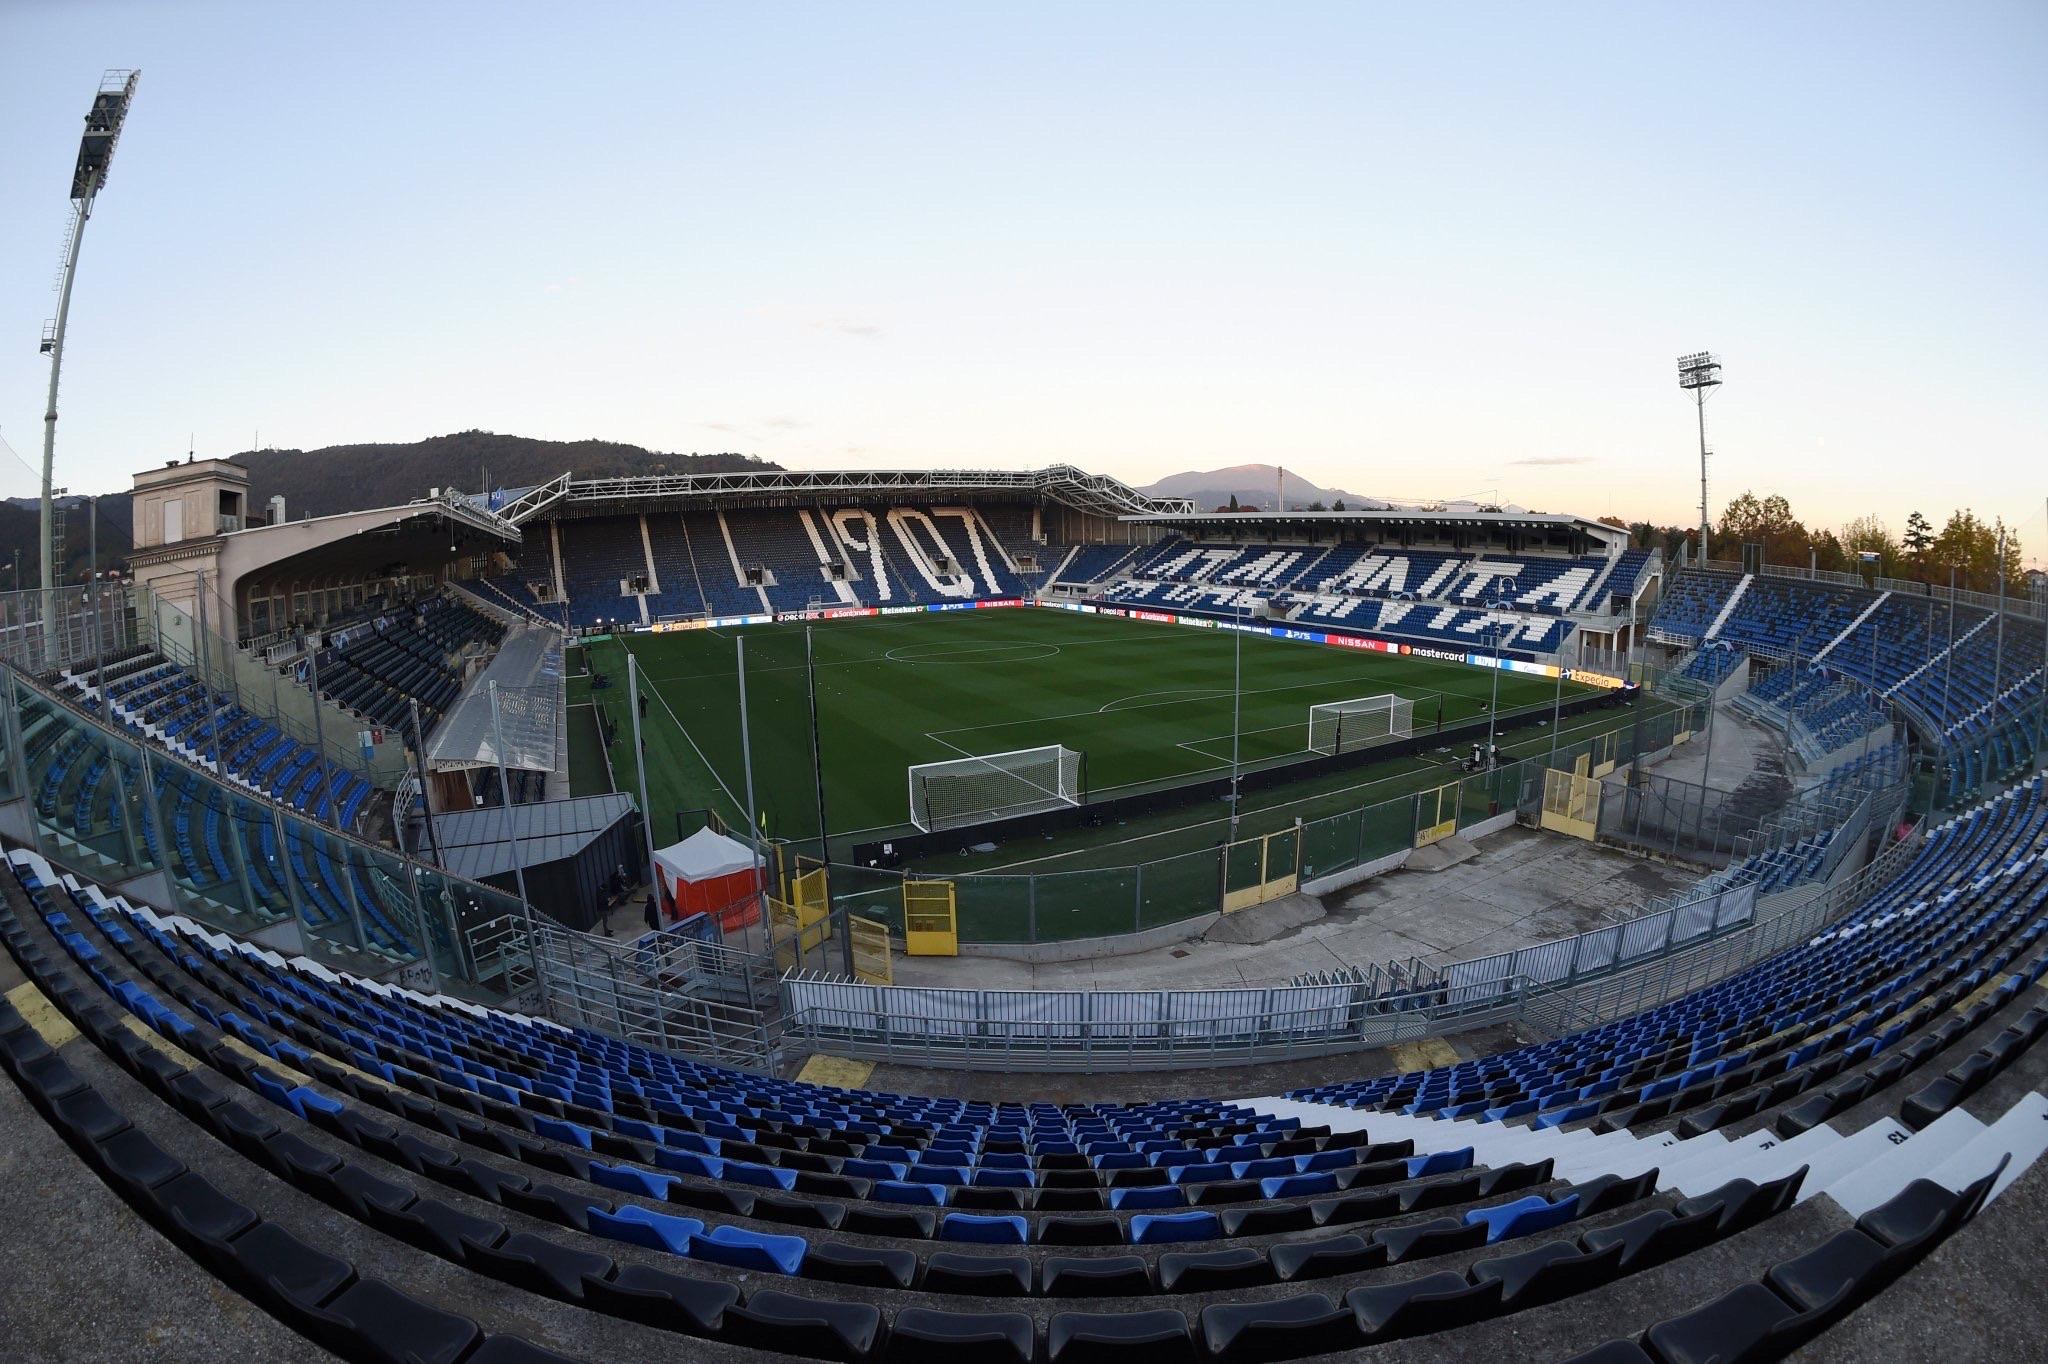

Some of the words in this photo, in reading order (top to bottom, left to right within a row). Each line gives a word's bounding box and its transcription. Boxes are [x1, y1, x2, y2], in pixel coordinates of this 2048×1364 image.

[799, 507, 1003, 603] 1907
[838, 609, 872, 618] Santander
[881, 606, 917, 614] Heineken
[784, 613, 806, 622] pepsi
[1144, 612, 1169, 622] Santander
[1178, 616, 1208, 628] Heineken
[1293, 631, 1311, 640] PS5
[1337, 636, 1376, 649] NISSAN
[1412, 647, 1465, 662] mastercard
[1575, 669, 1610, 687] Expedia
